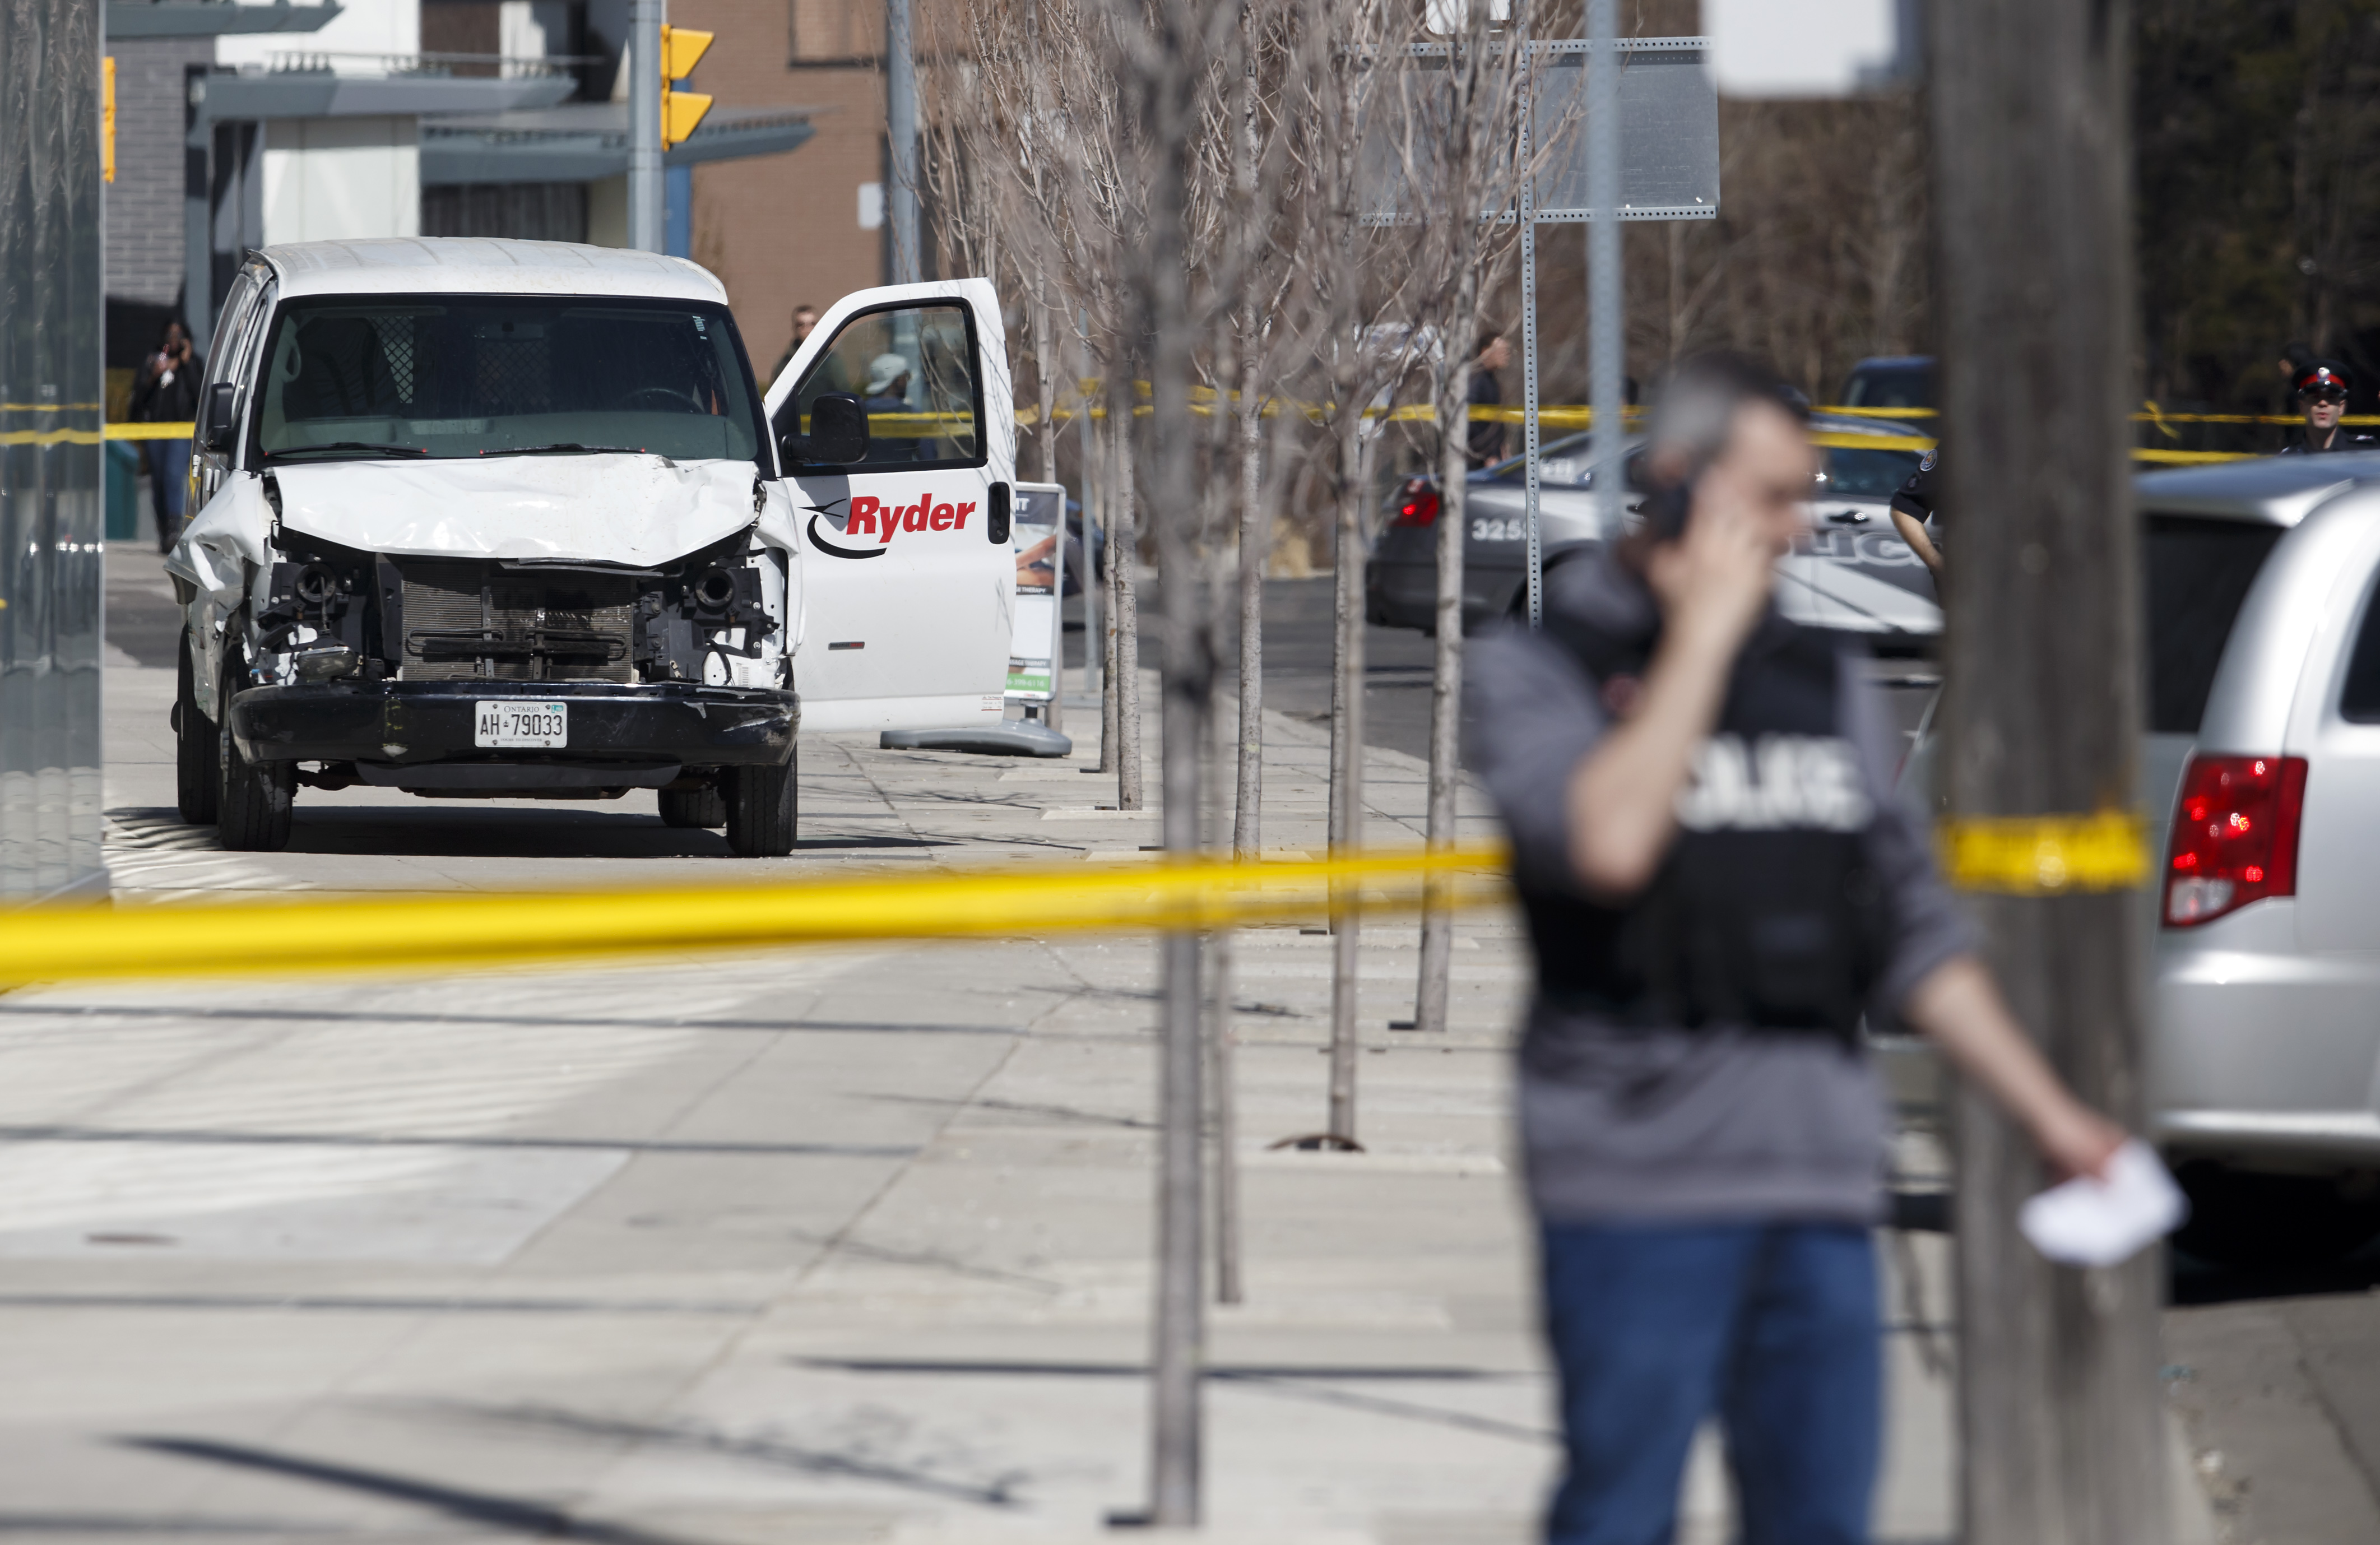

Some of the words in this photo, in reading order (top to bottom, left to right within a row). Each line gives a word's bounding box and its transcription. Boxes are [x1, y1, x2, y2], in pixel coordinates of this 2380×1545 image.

[846, 493, 976, 544] Ryder
[480, 714, 500, 735] AH
[511, 714, 563, 736] 79033
